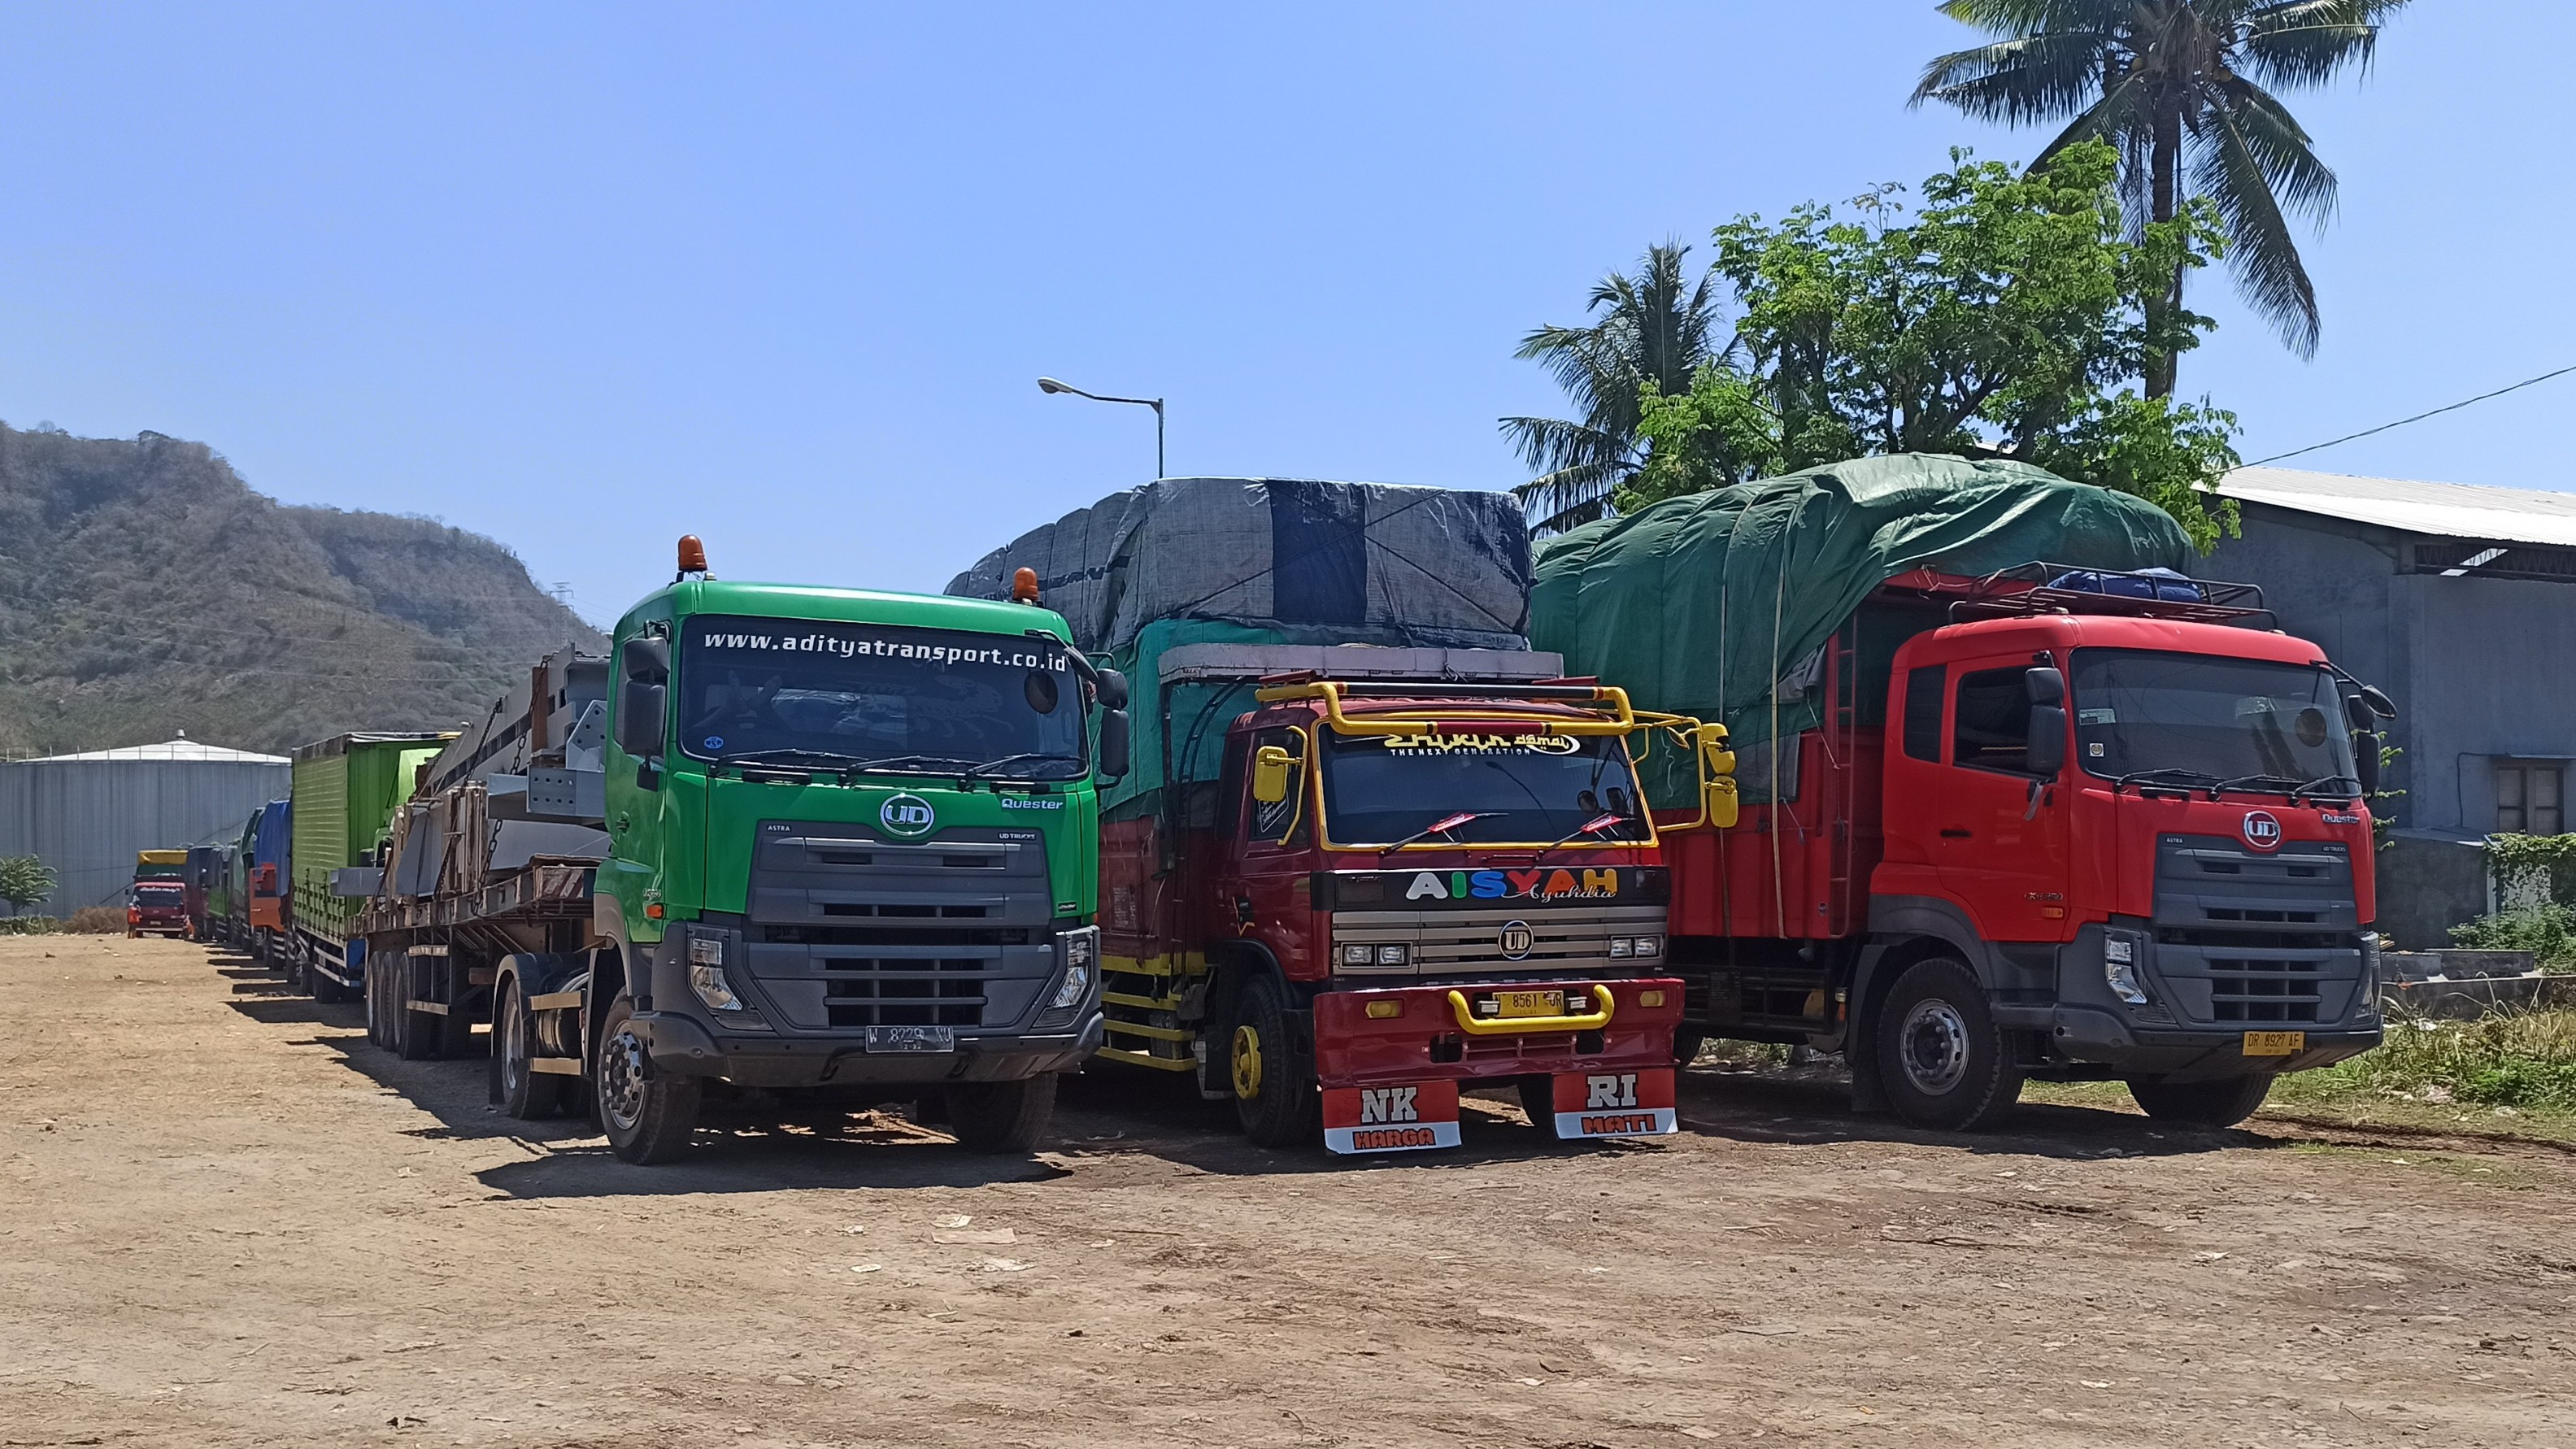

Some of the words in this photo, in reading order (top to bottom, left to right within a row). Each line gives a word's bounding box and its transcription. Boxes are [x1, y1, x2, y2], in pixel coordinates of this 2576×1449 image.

[704, 633, 1066, 672] www.adityatransport.co.id
[1390, 748, 1414, 756] THE
[1417, 748, 1449, 756] NEXT
[1454, 747, 1530, 755] GENERATION
[1001, 798, 1064, 810] Quester
[885, 804, 930, 825] UD
[2248, 820, 2278, 837] UD
[1405, 868, 1618, 901] AISYAH
[1504, 931, 1530, 950] UD
[1512, 994, 1538, 1008] 8561
[868, 1028, 878, 1044] W
[2247, 1033, 2260, 1047] DR
[2288, 1033, 2300, 1047] AF
[1586, 1073, 1638, 1109] RI
[1360, 1086, 1418, 1124] NK
[1582, 1113, 1658, 1135] MATI
[1352, 1127, 1437, 1151] HARGA
